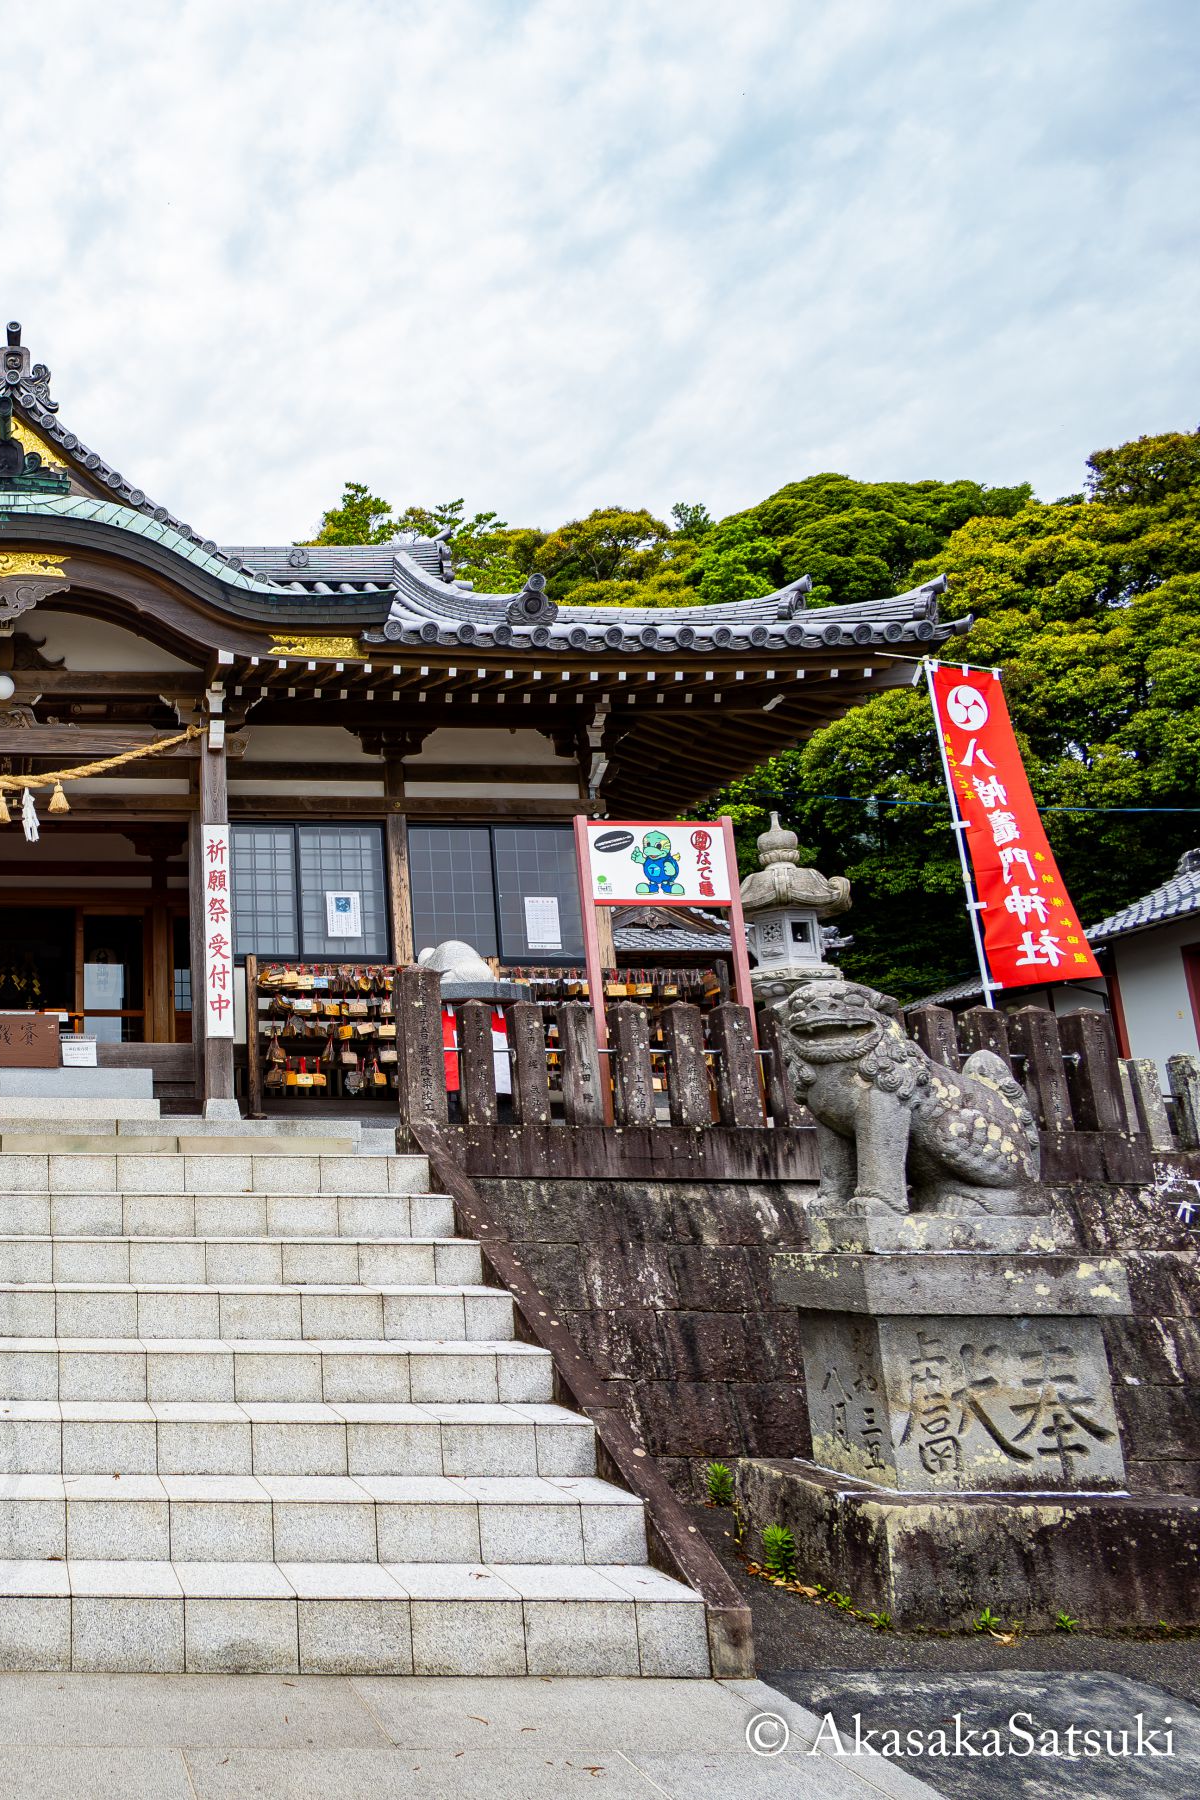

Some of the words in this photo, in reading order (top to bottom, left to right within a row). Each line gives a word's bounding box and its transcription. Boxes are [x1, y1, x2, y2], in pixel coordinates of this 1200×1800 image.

[206, 838, 230, 924] 祈願祭
[208, 932, 231, 1022] 受付中
